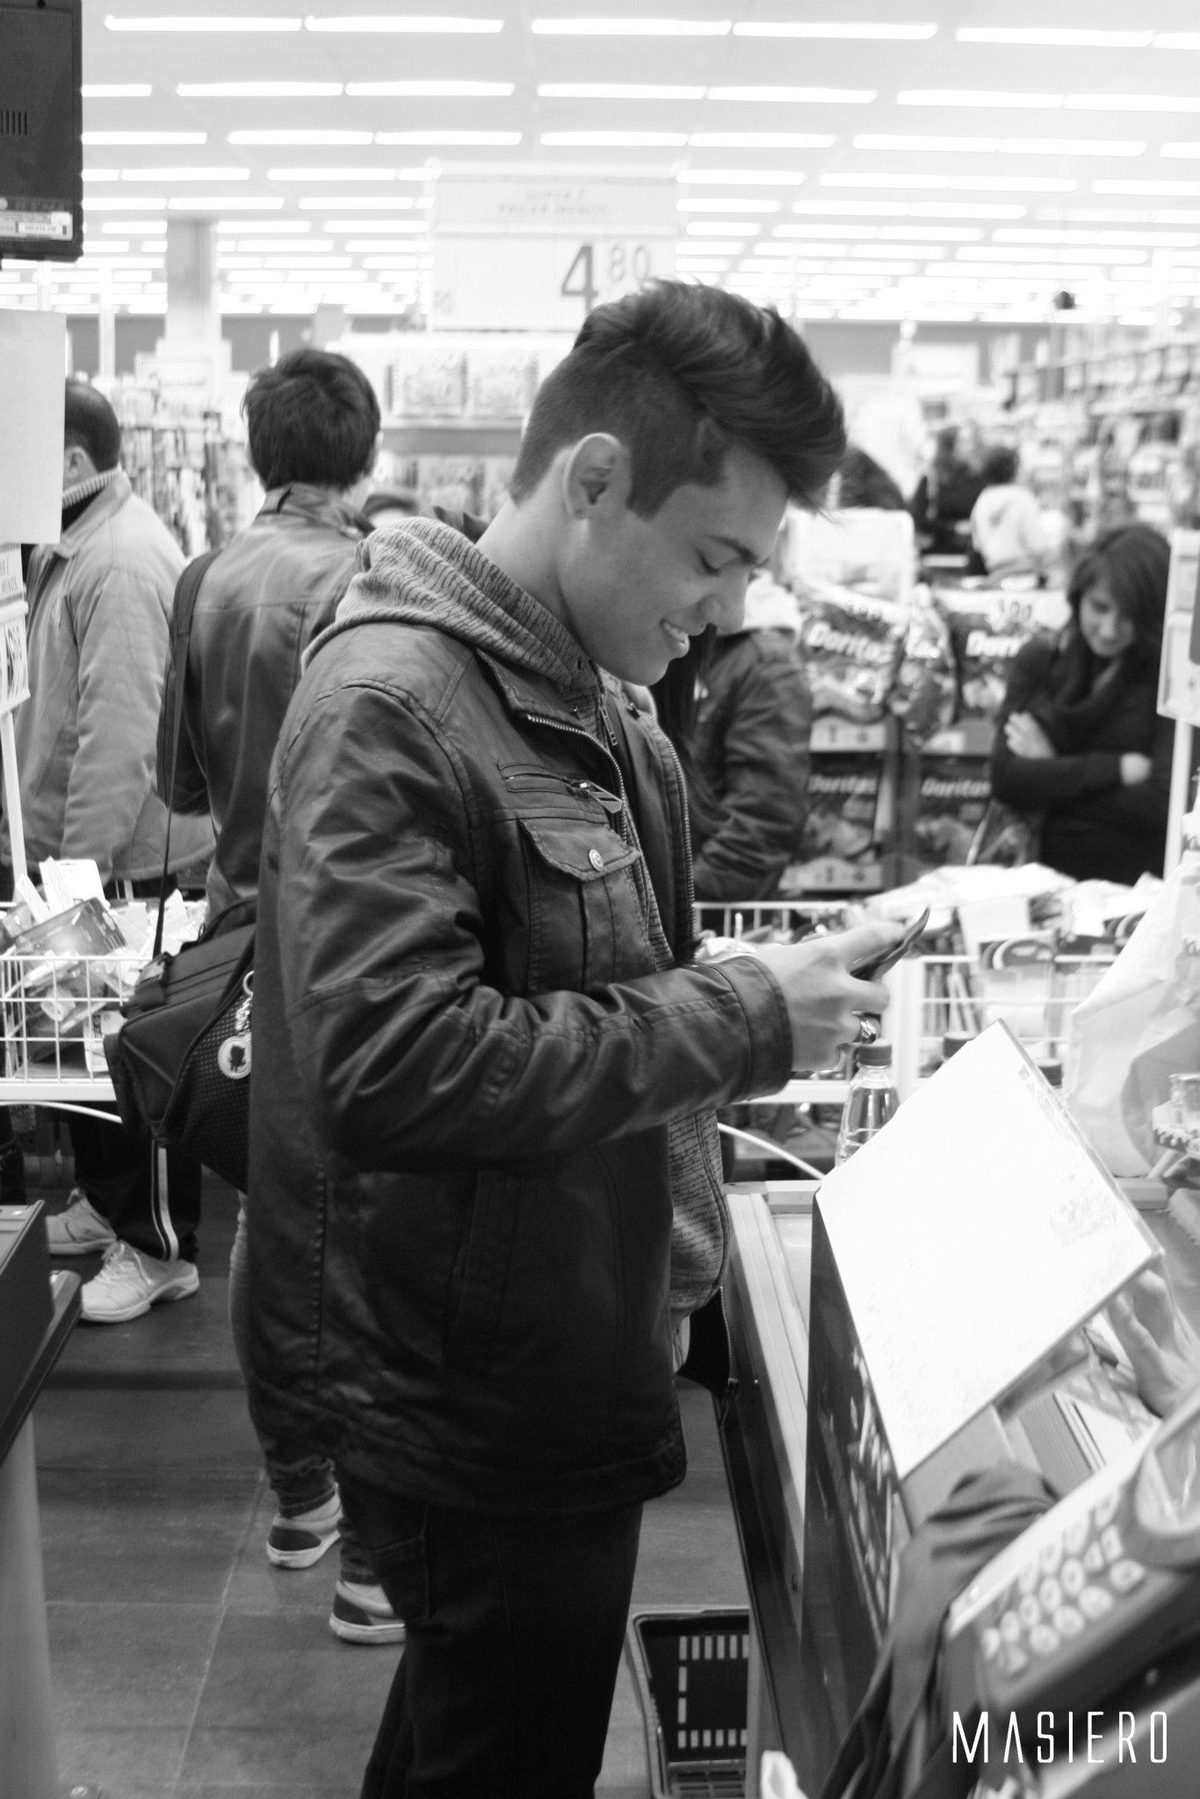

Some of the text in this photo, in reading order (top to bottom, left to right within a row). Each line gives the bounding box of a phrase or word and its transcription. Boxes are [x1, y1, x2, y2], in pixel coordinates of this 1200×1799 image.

[806, 622, 895, 664] Doritos
[808, 774, 877, 794] Doritos
[921, 777, 992, 798] Doritos
